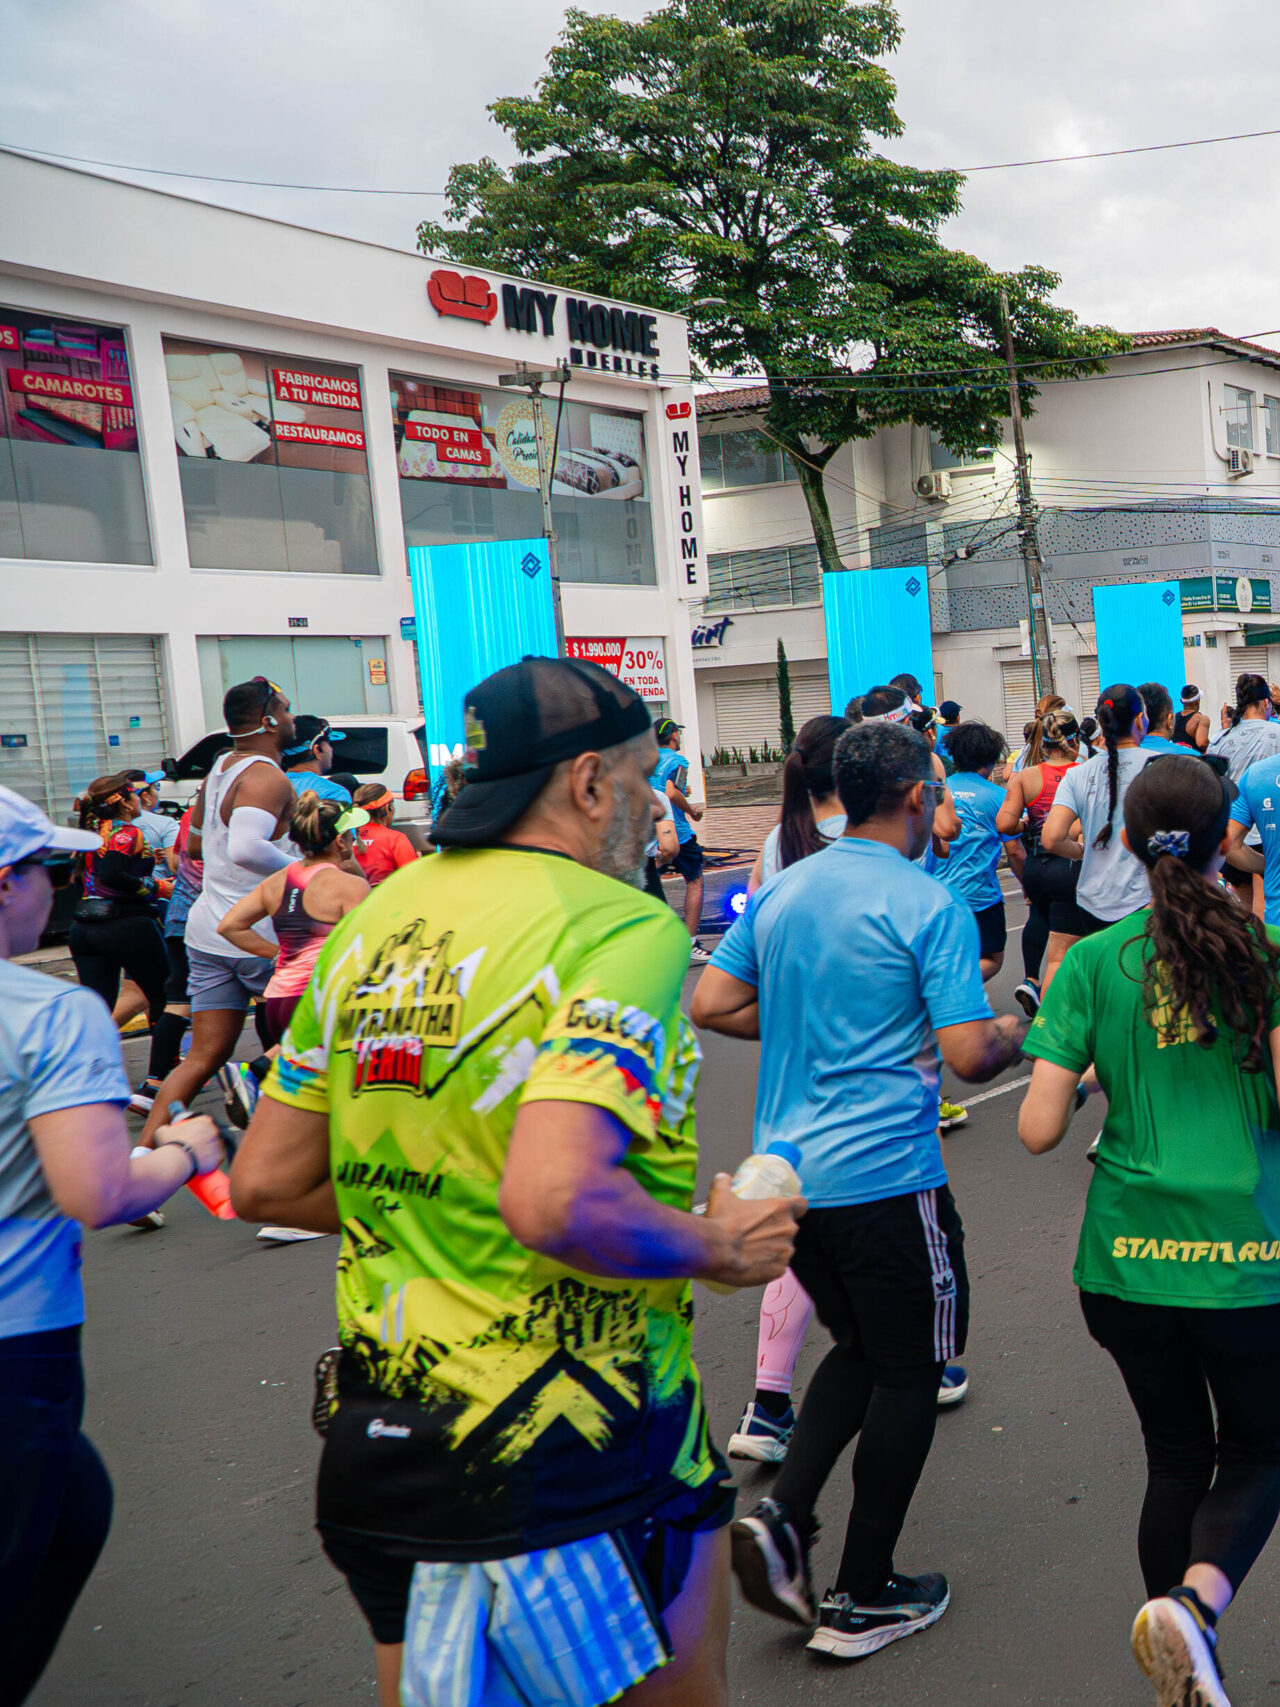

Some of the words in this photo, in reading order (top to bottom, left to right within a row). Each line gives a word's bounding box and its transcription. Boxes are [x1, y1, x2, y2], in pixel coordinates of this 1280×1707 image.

[502, 284, 557, 336] MY
[566, 298, 659, 356] HOME
[570, 347, 659, 380] MUEBLES
[23, 374, 123, 401] CAMAROTES
[279, 371, 357, 393] FABRICAMOS
[280, 387, 289, 399] A
[292, 388, 308, 400] TU
[312, 391, 360, 408] MEDIDA
[275, 424, 363, 445] RESTAURAMOS
[415, 426, 449, 440] TODO
[453, 431, 468, 443] EN
[446, 448, 482, 462] CAMAS
[672, 431, 689, 476] MY
[678, 485, 698, 585] HOME
[581, 643, 621, 657] 1.990.000
[625, 650, 663, 670] 30%
[624, 677, 635, 686] EN
[637, 677, 659, 685] TODA
